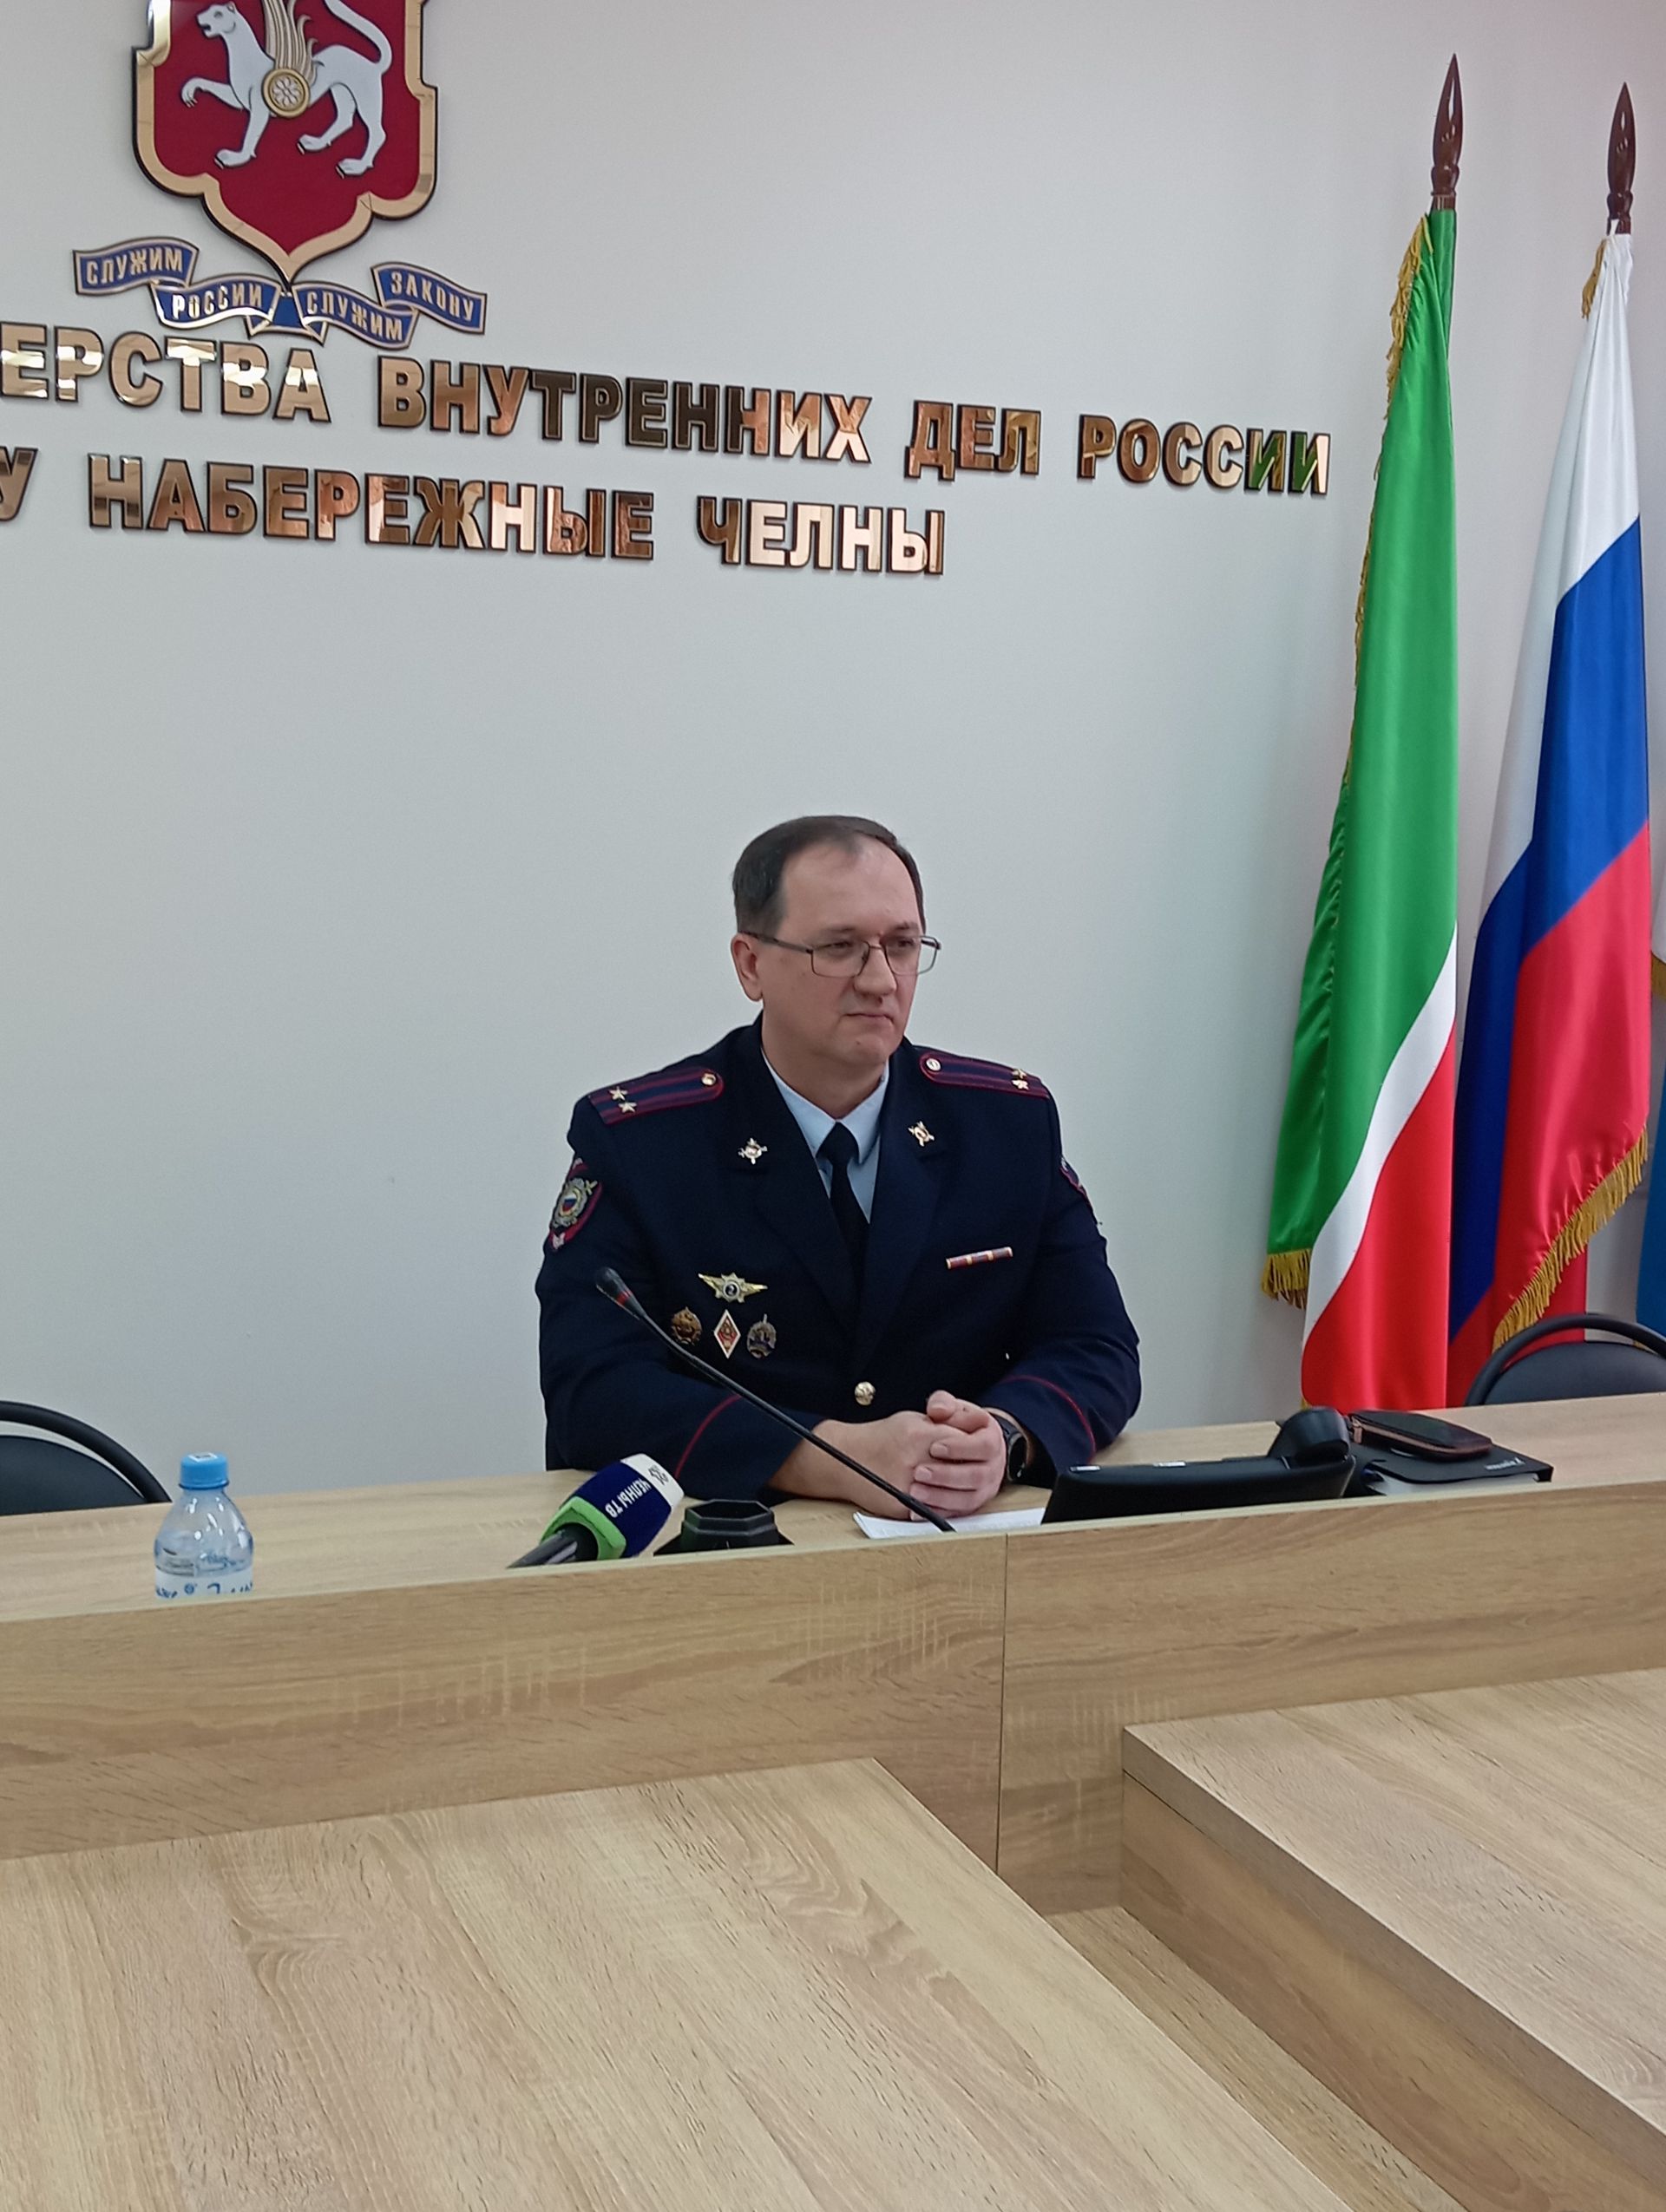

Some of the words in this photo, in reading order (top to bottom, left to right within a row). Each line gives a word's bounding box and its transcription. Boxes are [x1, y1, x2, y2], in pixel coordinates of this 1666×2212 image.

[85, 246, 184, 286] СЛУЖИМ
[171, 282, 264, 321] РОССИИ
[305, 288, 404, 344] СЛУЖИМ
[389, 271, 476, 324] ЗАКОНУ
[0, 321, 331, 422] ЕРСТВА
[377, 355, 872, 464] ВНУТРЕННИХ
[904, 400, 1041, 481] ДЕЛ
[1077, 414, 1331, 495] РОССИИ
[88, 453, 655, 560] НАБЕРЕЖНЫЕ
[697, 496, 946, 574] ЧЕЛНЫ
[605, 1499, 624, 1518] ТВ
[617, 1477, 652, 1508] ЧЕЛНЫ
